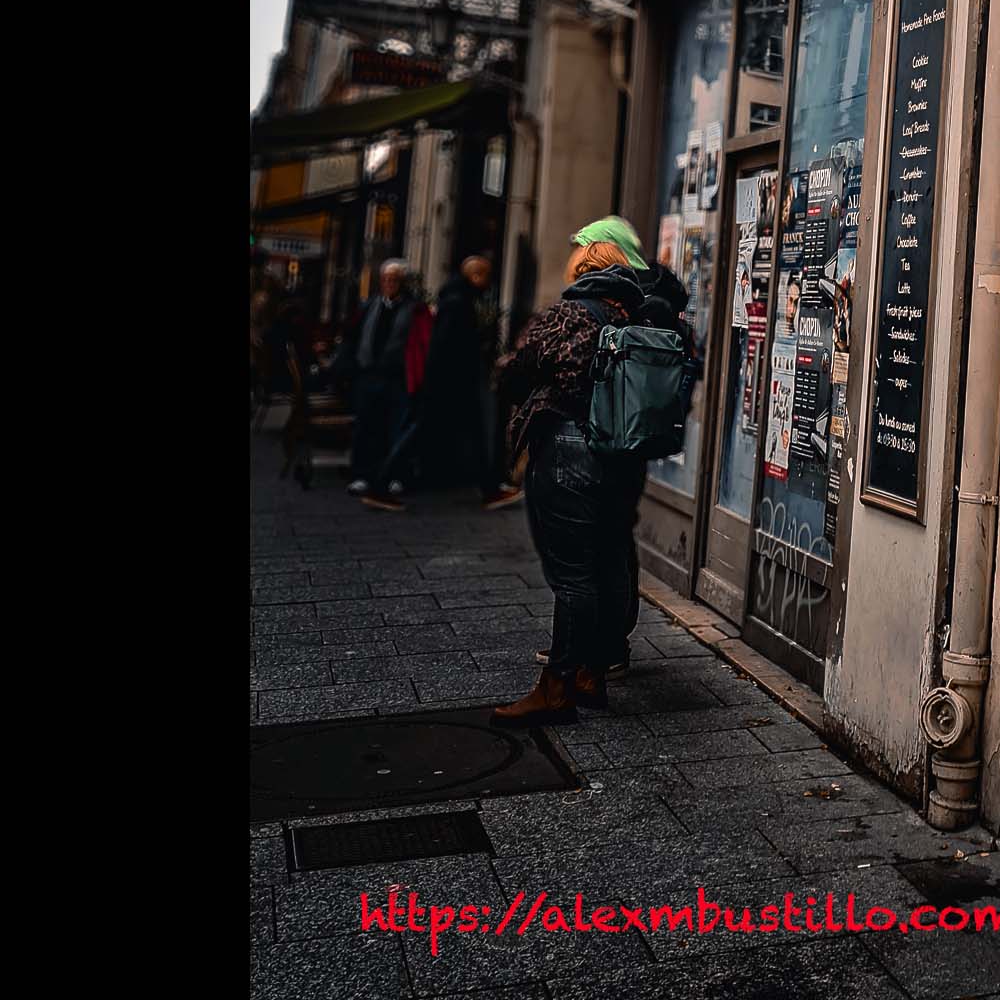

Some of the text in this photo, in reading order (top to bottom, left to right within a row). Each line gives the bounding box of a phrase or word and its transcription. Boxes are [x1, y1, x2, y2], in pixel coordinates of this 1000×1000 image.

[912, 55, 929, 69] Cookies
[911, 78, 928, 93] Muffins
[907, 100, 928, 114] Brownies
[809, 167, 832, 189] CHOPIN
[901, 212, 917, 228] Coffee
[896, 235, 918, 248] Chocolate
[901, 258, 910, 271] Tea
[897, 281, 911, 295] Latte
[799, 316, 822, 338] CHOPIN
